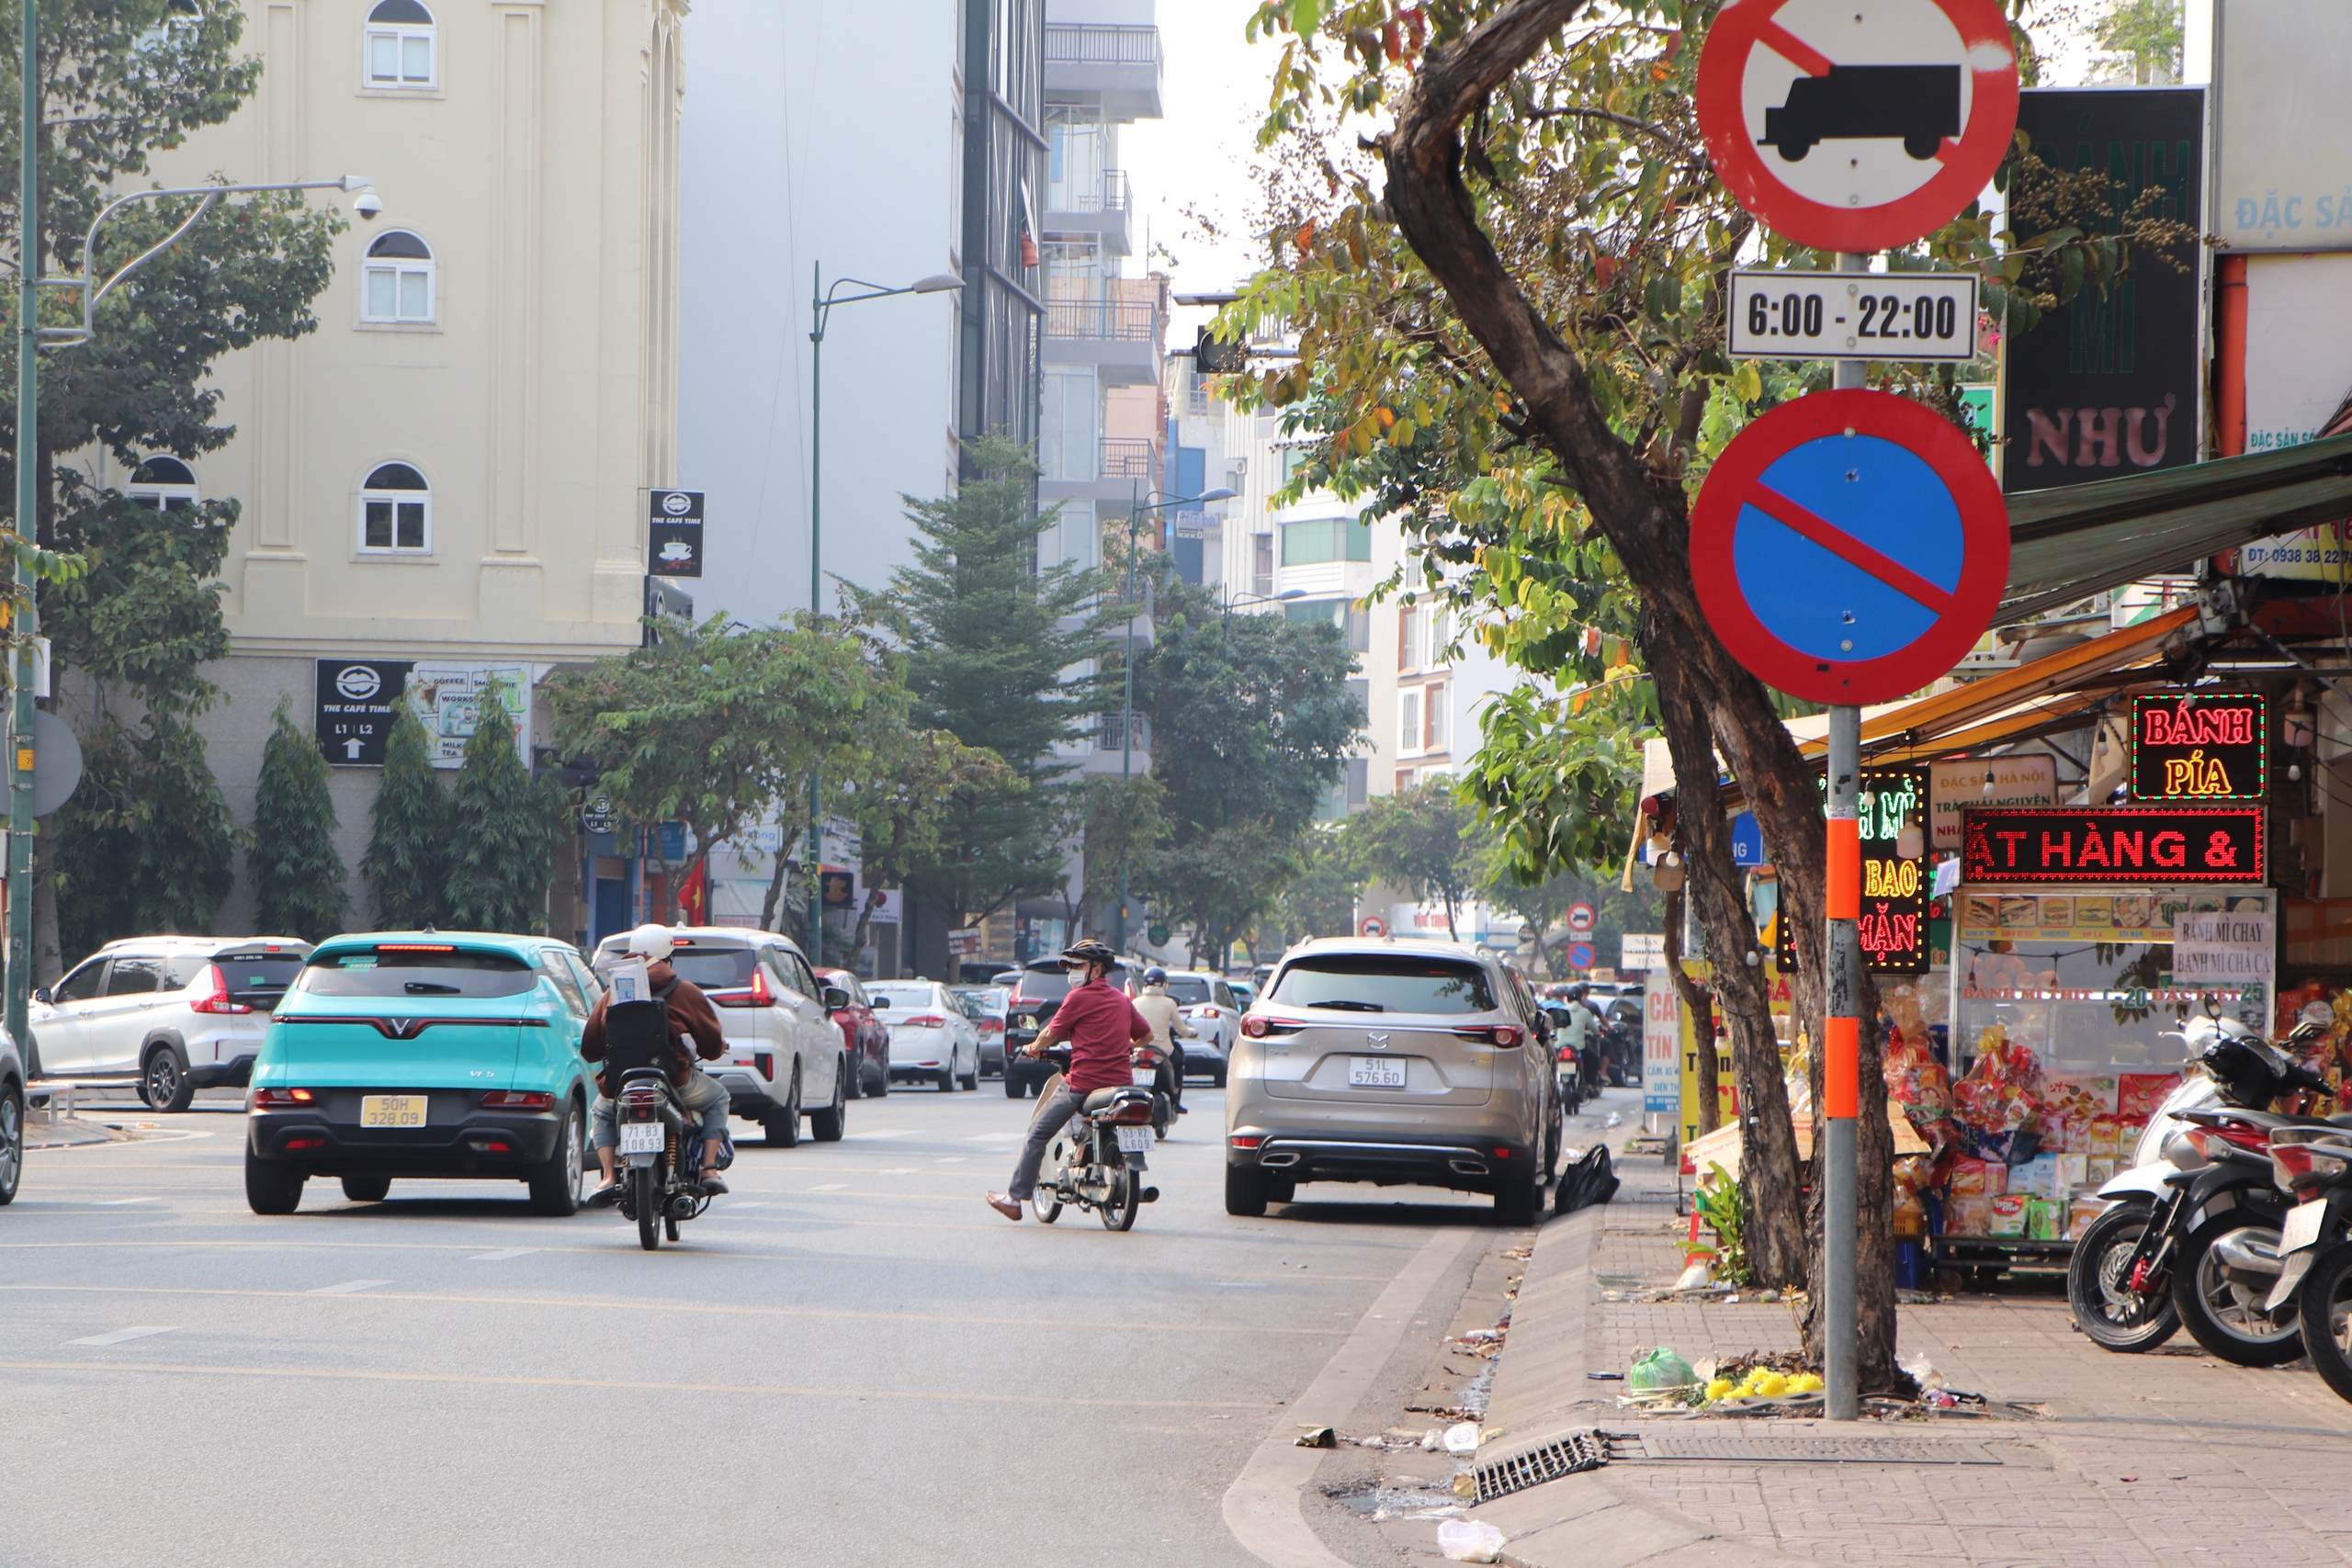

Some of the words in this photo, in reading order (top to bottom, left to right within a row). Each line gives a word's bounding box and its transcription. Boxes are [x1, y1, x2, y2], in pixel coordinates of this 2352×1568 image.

[2234, 187, 2302, 239] ĐẶC
[1749, 293, 1824, 337] 6:00
[1858, 295, 1956, 339] 22:00
[2026, 392, 2177, 467] NHƯ
[1178, 510, 1221, 526] Global
[2248, 548, 2268, 561] ĐT:
[2273, 548, 2301, 562] 0938
[2305, 549, 2321, 563] 38
[2324, 550, 2339, 564] 22
[344, 703, 366, 713] CAFÉ
[335, 724, 347, 734] L1
[359, 724, 373, 734] L2
[2144, 700, 2253, 745] BÁNH
[443, 741, 462, 750] MILK
[1940, 775, 1967, 789] ĐẶC
[1970, 773, 1996, 786] SẢ
[1999, 771, 2018, 784] HÀ
[2021, 769, 2045, 784] NỘI
[2165, 750, 2232, 794] PÍA
[2041, 822, 2186, 867] HÀNG
[2205, 830, 2237, 867] &
[1864, 860, 1918, 897] BAO
[2183, 918, 2212, 942] BÁNH
[2216, 916, 2230, 942] MÌ
[2233, 922, 2264, 942] CHAY
[2177, 947, 2208, 973] BÁNH
[2211, 947, 2225, 973] MÌ
[2228, 947, 2252, 973] CHẢ
[2254, 947, 2270, 973] CÁ
[1962, 984, 2016, 999] BÁNH
[2021, 986, 2042, 999] MÌ
[2048, 987, 2093, 1002] THỊT
[2152, 986, 2193, 1003] ĐẶC
[2241, 982, 2263, 1001] 25
[1646, 1031, 1673, 1060] TÍN
[1365, 1058, 1389, 1071] 51L
[1355, 1071, 1400, 1084] 576.60
[381, 1099, 409, 1111] 50H
[368, 1112, 419, 1125] 328.09
[624, 1138, 662, 1150] 108.93
[1125, 1139, 1150, 1150] 4609
